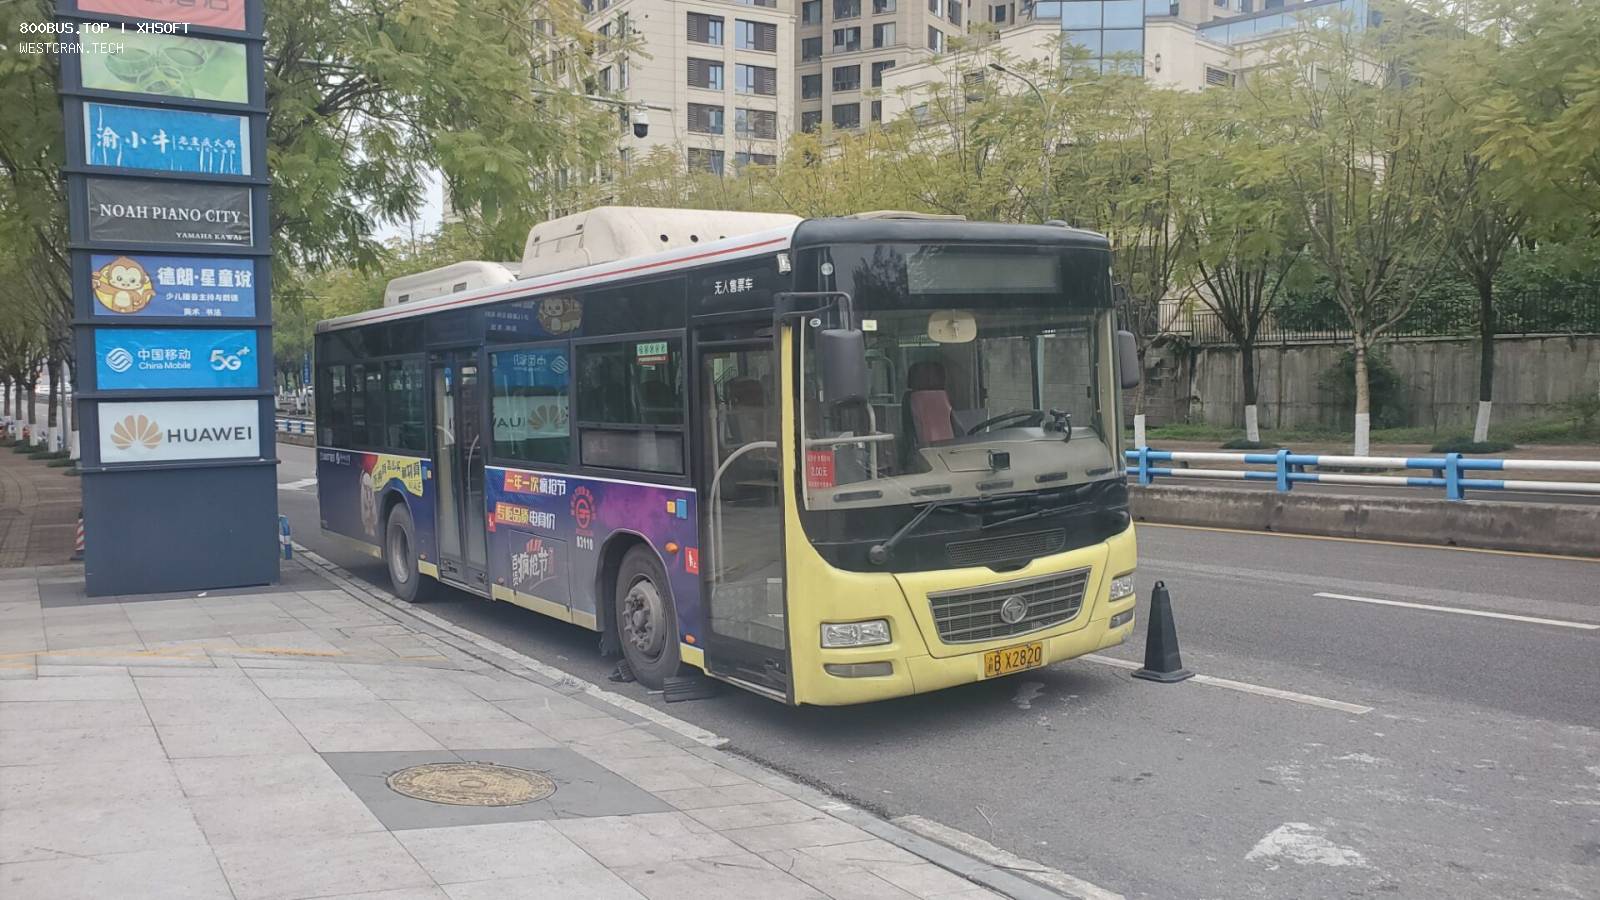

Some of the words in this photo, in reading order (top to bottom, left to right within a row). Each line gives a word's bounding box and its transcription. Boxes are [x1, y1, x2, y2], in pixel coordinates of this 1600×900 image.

[95, 126, 170, 154] 渝小牛
[99, 203, 148, 219] NOAH
[152, 206, 201, 222] PIANO
[205, 208, 241, 224] CITY
[176, 232, 213, 240] YAMAHA
[214, 233, 242, 241] KAWAI
[157, 266, 252, 288] 德朗·星童说
[714, 277, 753, 296] 无人售票车
[138, 348, 191, 361] 中国移动
[138, 361, 163, 370] China
[164, 361, 191, 370] Mobile
[167, 426, 252, 443] HUAWEI
[506, 474, 567, 496] 一年一次疯抢节
[1005, 646, 1041, 669] X2820
